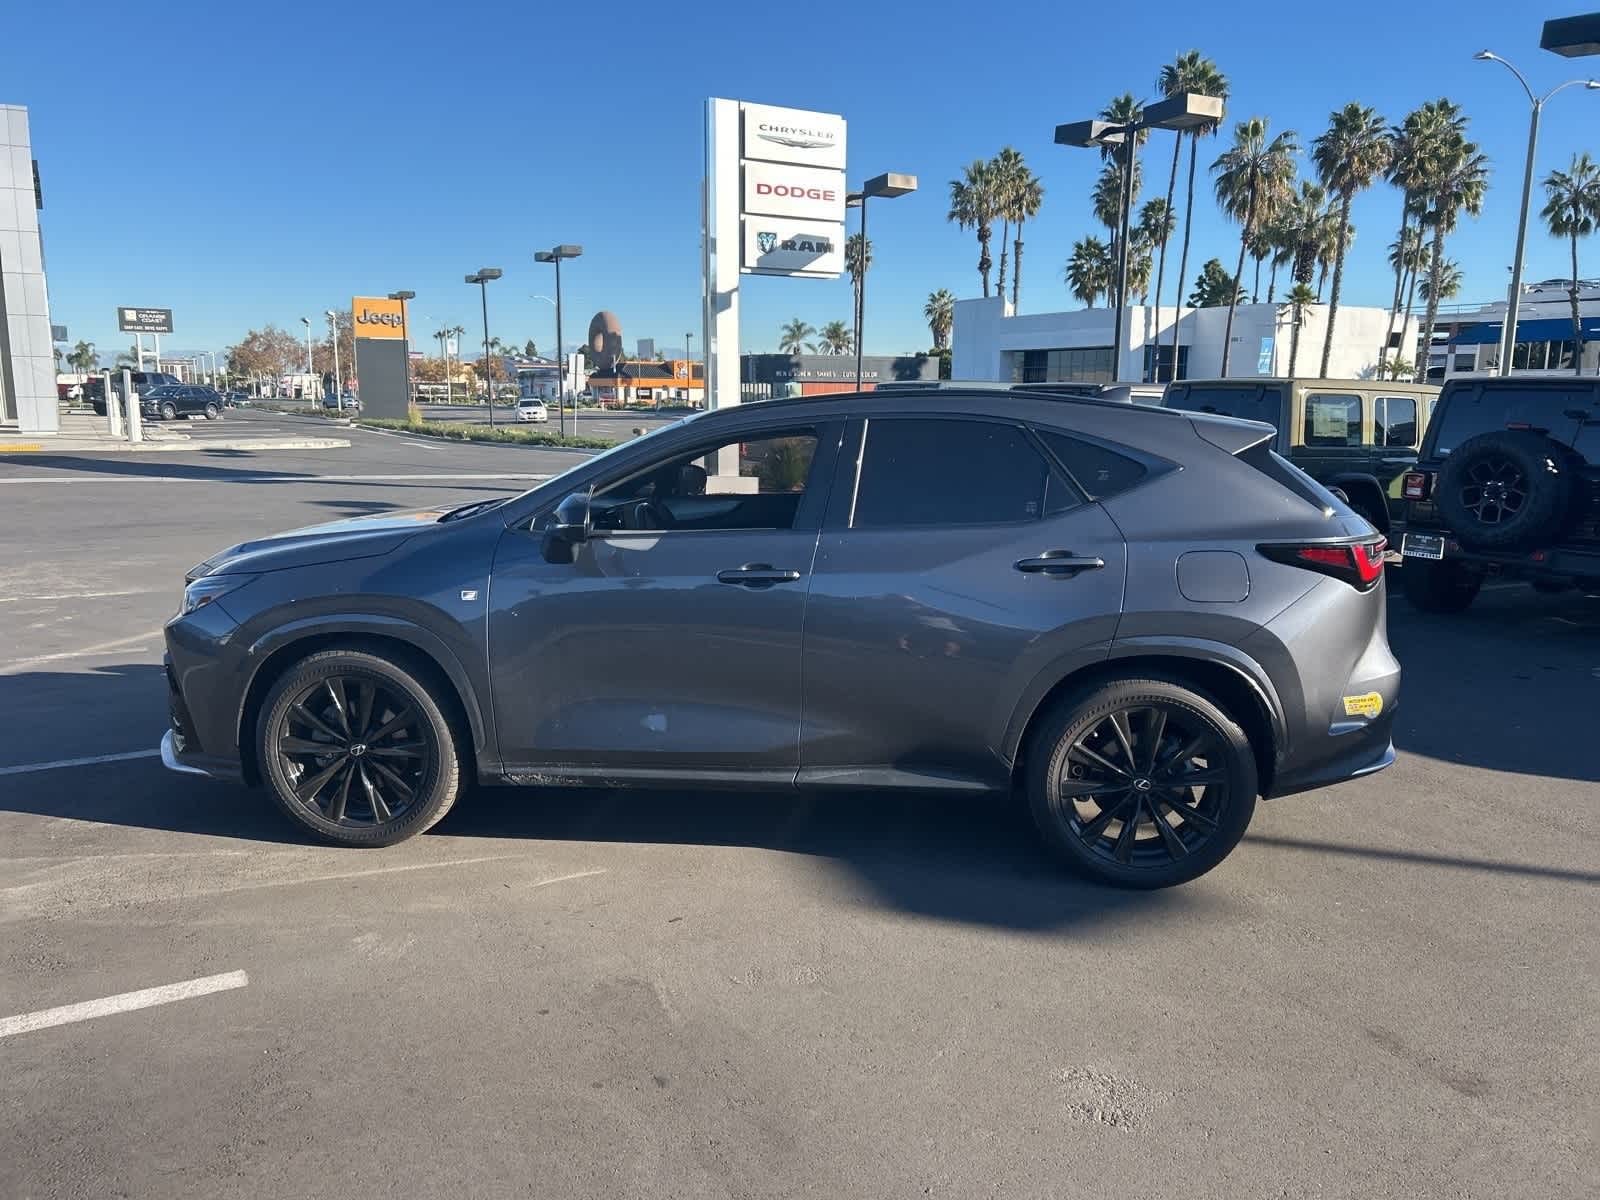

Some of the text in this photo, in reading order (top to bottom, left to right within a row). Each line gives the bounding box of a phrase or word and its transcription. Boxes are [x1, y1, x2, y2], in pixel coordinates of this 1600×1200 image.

[759, 124, 834, 139] CHRYSLER
[756, 183, 836, 201] DODGE
[781, 239, 834, 253] RAM
[356, 308, 403, 328] Jeep
